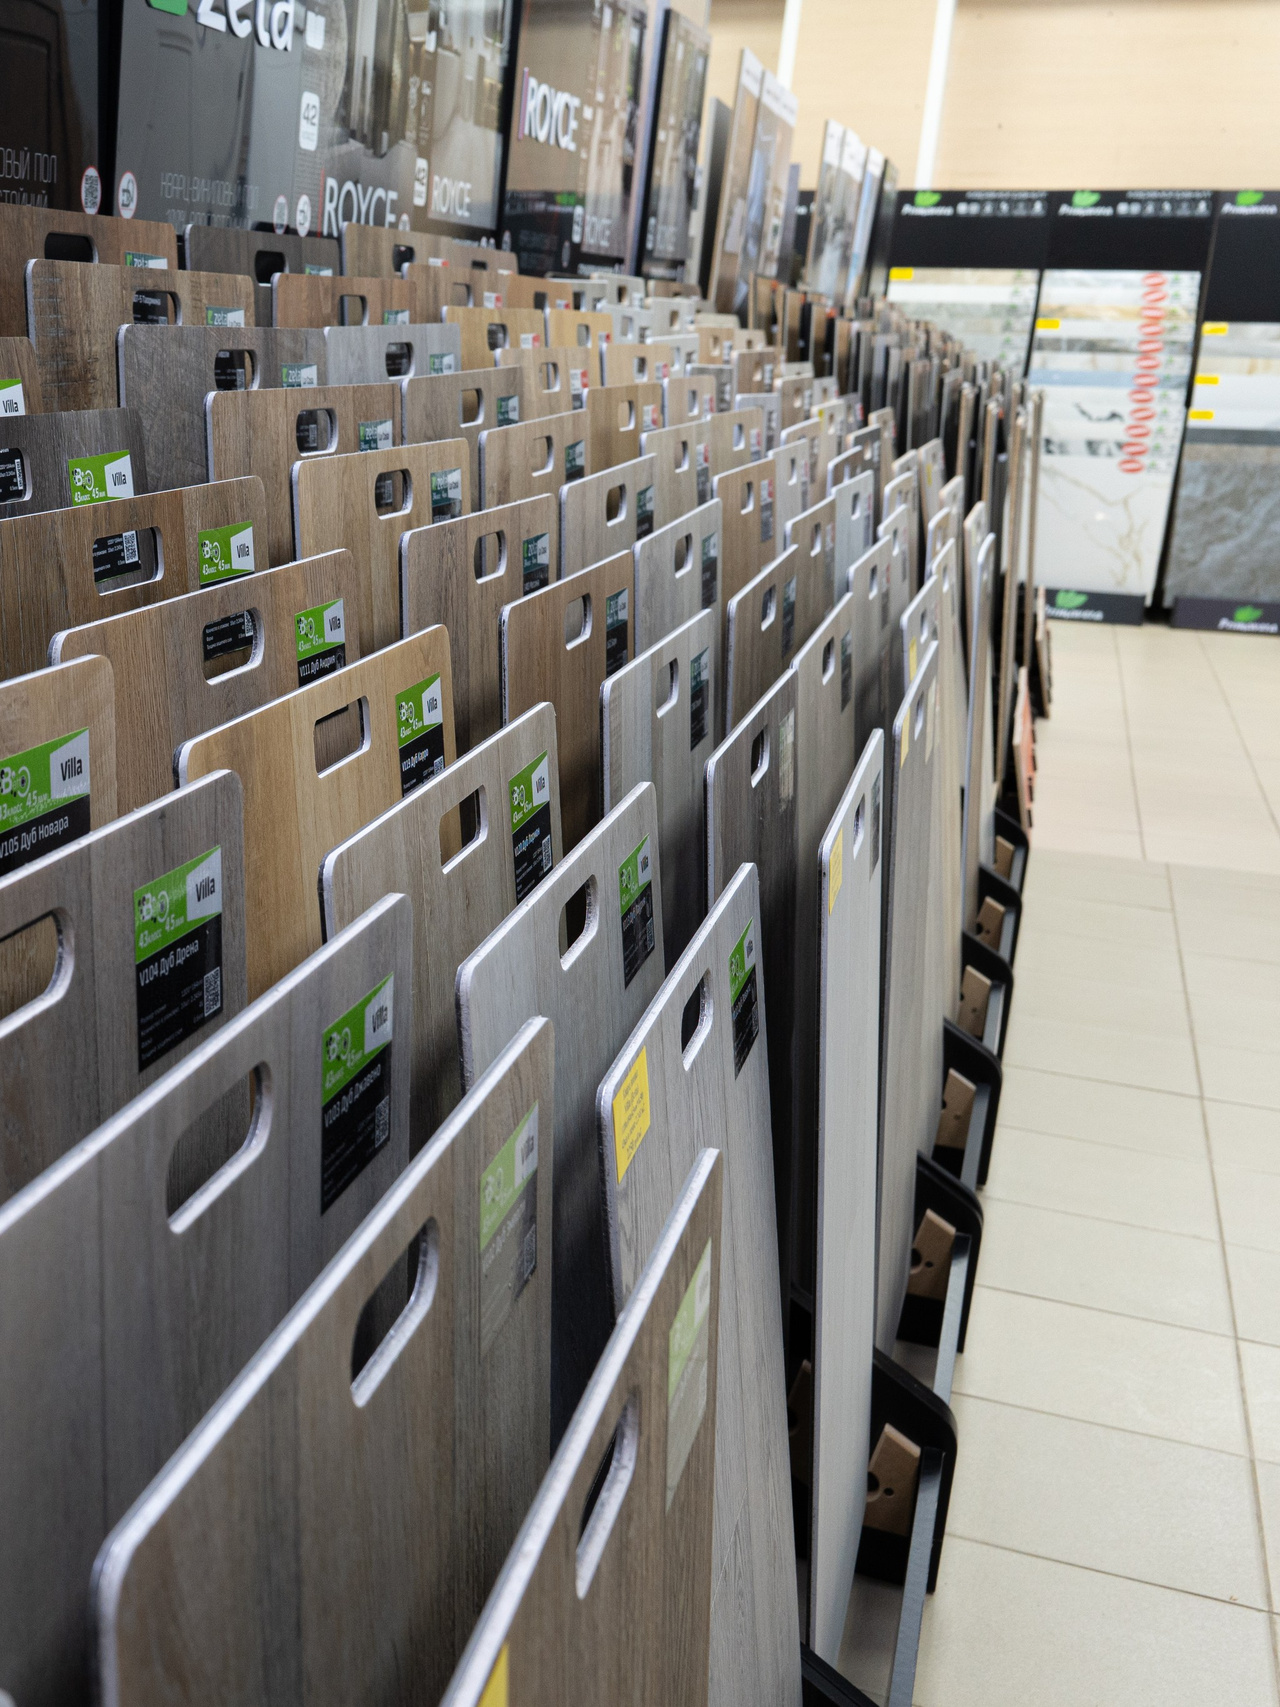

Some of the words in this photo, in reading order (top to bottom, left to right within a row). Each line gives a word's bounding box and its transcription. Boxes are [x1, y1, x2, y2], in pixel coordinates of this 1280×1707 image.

[302, 102, 318, 127] 42
[524, 77, 581, 152] ROYCE
[33, 152, 58, 184] ПОЛ
[322, 176, 399, 238] ROYCE
[432, 175, 472, 218] ROYCE
[2, 399, 19, 414] Villa
[111, 472, 128, 487] Villa
[236, 544, 250, 559] Villa
[60, 756, 83, 781] Villa
[20, 830, 37, 851] Дуб
[38, 815, 69, 841] Новара
[195, 876, 216, 903] Villa
[139, 963, 159, 988] V104
[159, 956, 175, 978] Дуб
[175, 938, 199, 967] Дрена
[371, 1004, 388, 1034] Villa
[340, 1091, 354, 1114] Дуб
